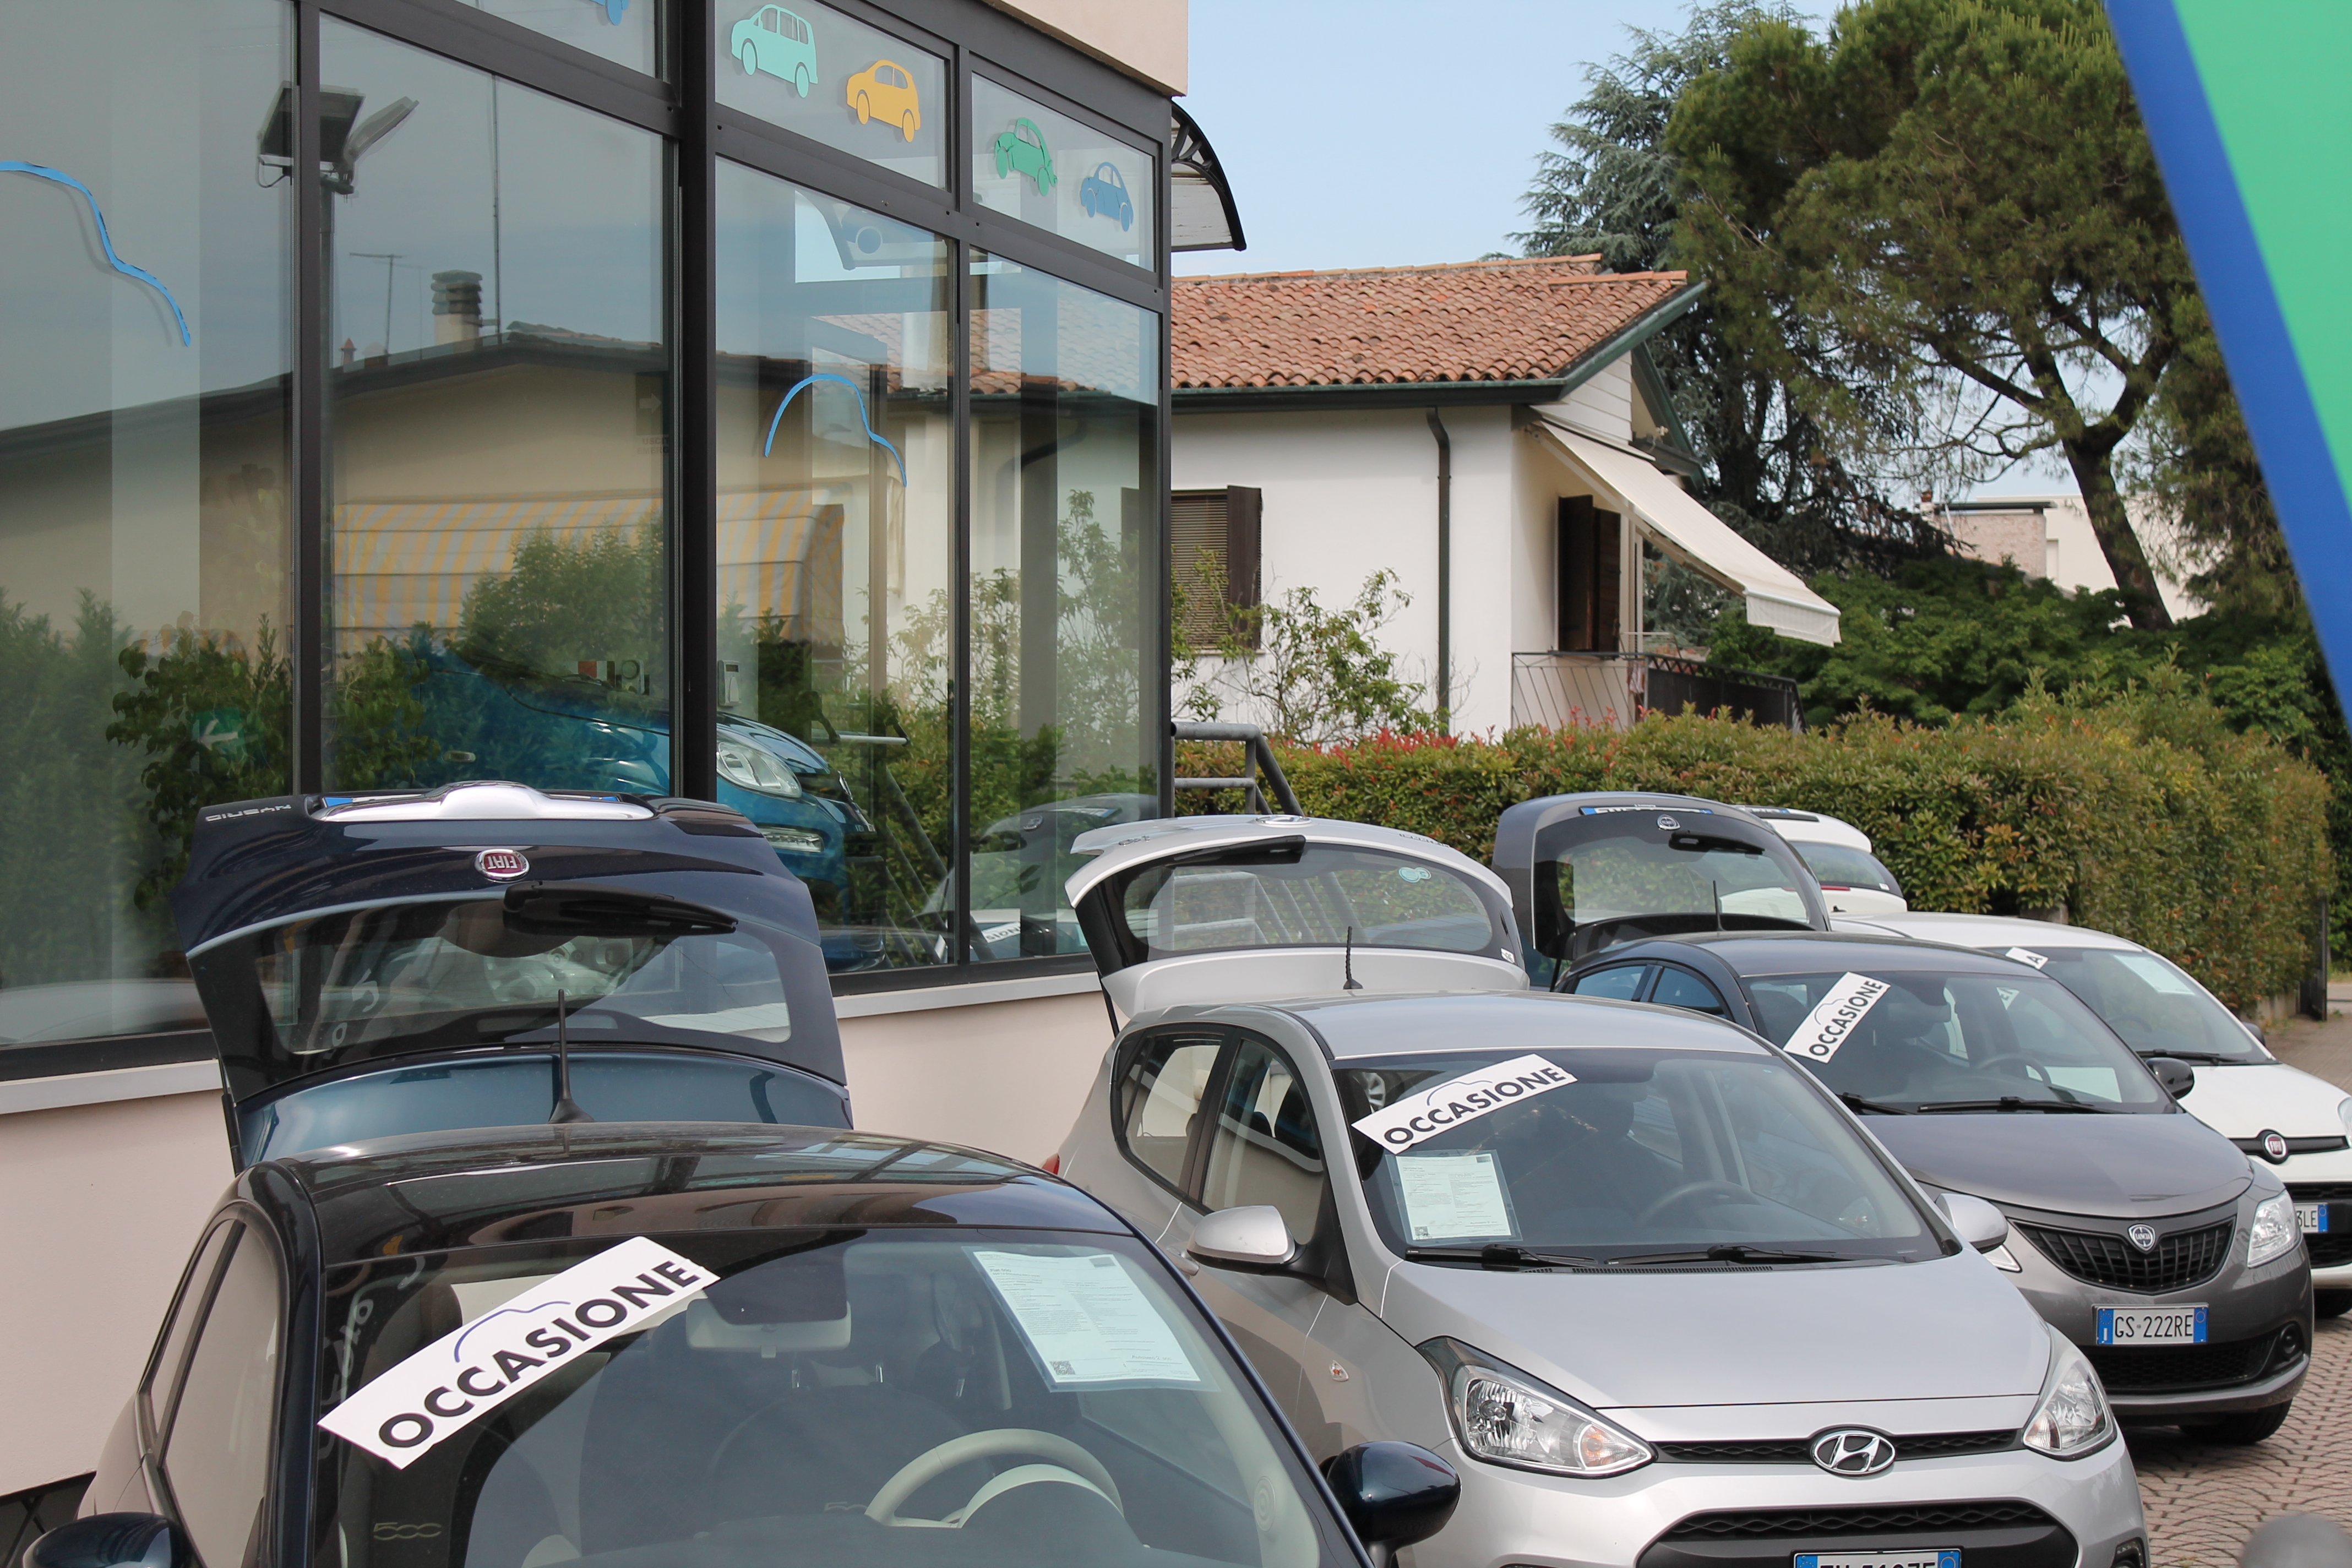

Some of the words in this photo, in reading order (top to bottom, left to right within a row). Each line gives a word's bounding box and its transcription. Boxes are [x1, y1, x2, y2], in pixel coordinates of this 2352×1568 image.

[487, 855, 518, 869] FIAT
[1809, 980, 1884, 1057] OCCASIONE
[1384, 1067, 1567, 1145] OCCASIONE
[378, 1260, 701, 1449] OCCASIONE
[373, 1521, 442, 1541] 500
